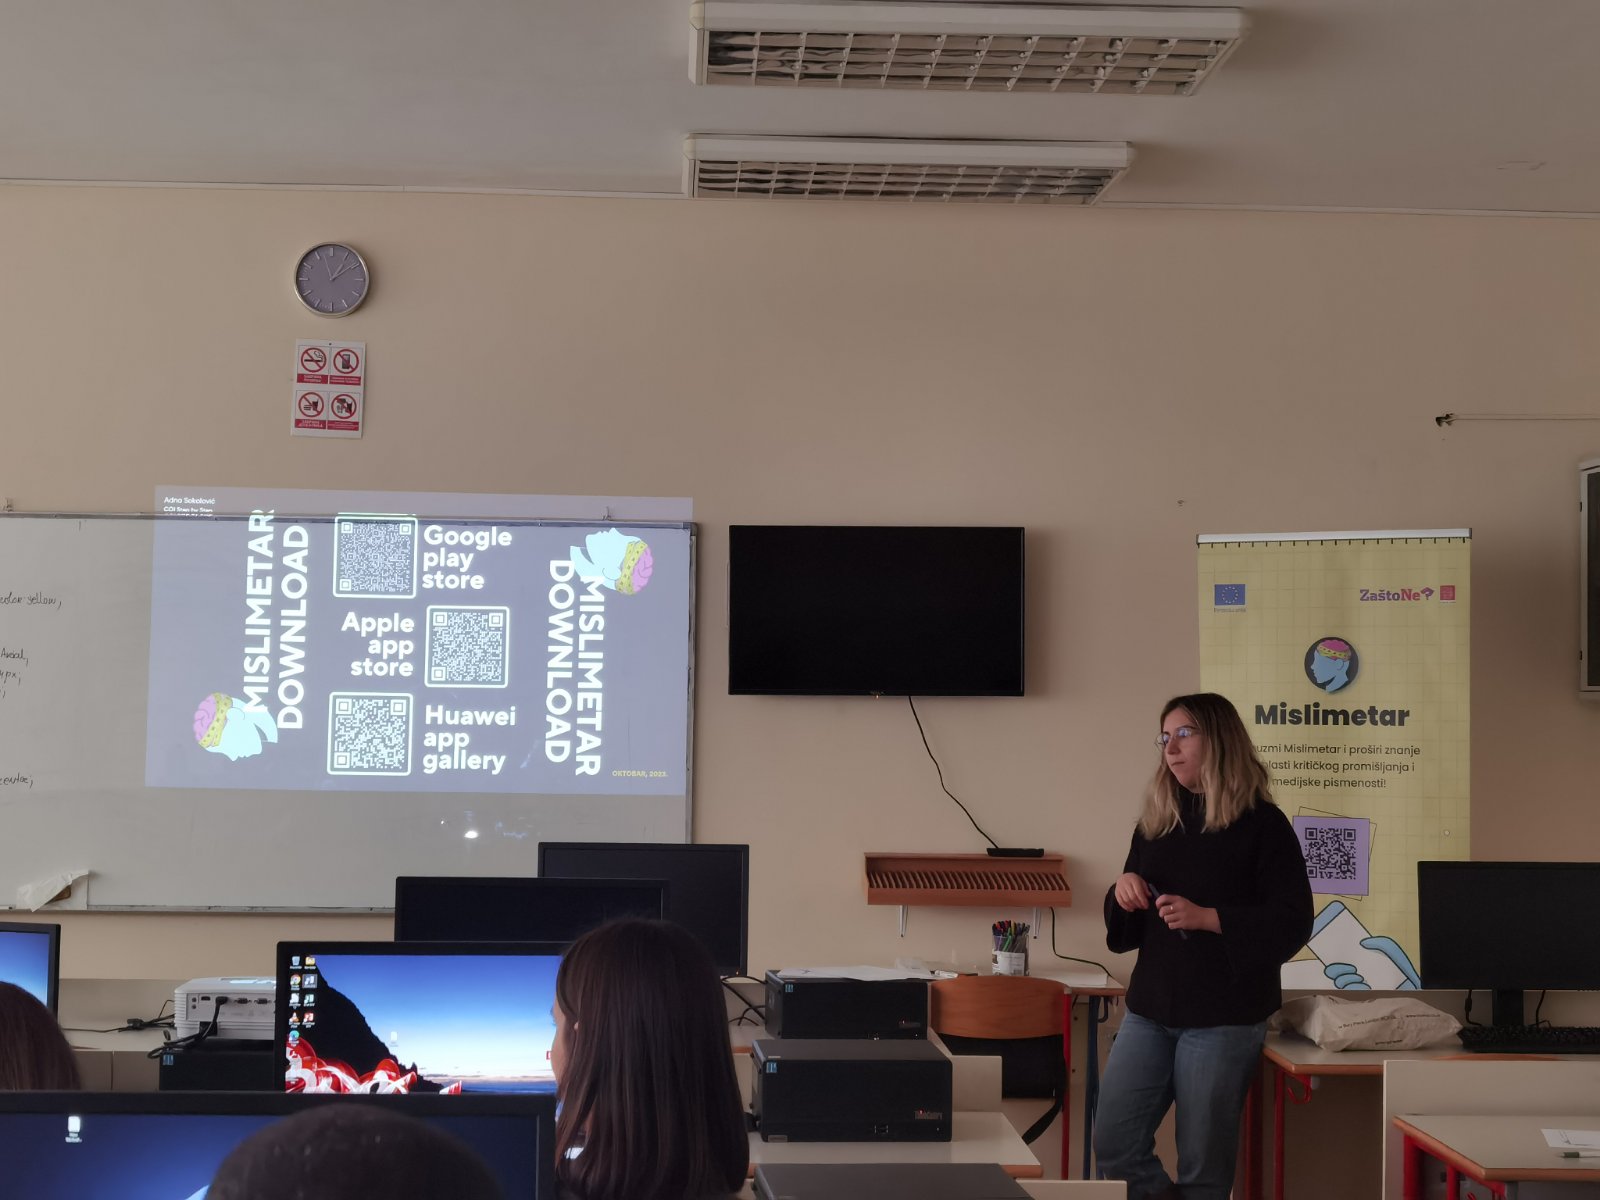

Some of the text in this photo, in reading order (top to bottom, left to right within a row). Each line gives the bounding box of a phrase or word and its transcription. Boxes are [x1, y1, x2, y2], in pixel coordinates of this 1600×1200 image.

[423, 524, 513, 551] Google
[422, 547, 474, 572] play
[422, 570, 485, 589] store
[243, 509, 275, 714] MISLIMETAR
[341, 611, 415, 637] Apple
[277, 525, 309, 729] DOWNLOAD
[368, 639, 414, 660] app
[545, 560, 575, 763] DOWNLOAD
[350, 658, 414, 677] store
[575, 574, 605, 776] MISLIMETAR
[425, 704, 516, 726] Huawei
[1255, 702, 1410, 727] Mislimetar
[423, 731, 470, 752] app
[1256, 744, 1282, 753] uzmi
[1283, 744, 1342, 754] Mislimetar
[1349, 744, 1383, 757] proširi
[1384, 745, 1421, 758] znanje
[422, 750, 507, 775] gallery
[1293, 760, 1340, 773] kritičkog
[1342, 761, 1409, 774] promišljanja
[1271, 777, 1386, 790] medijske pismenosti!
